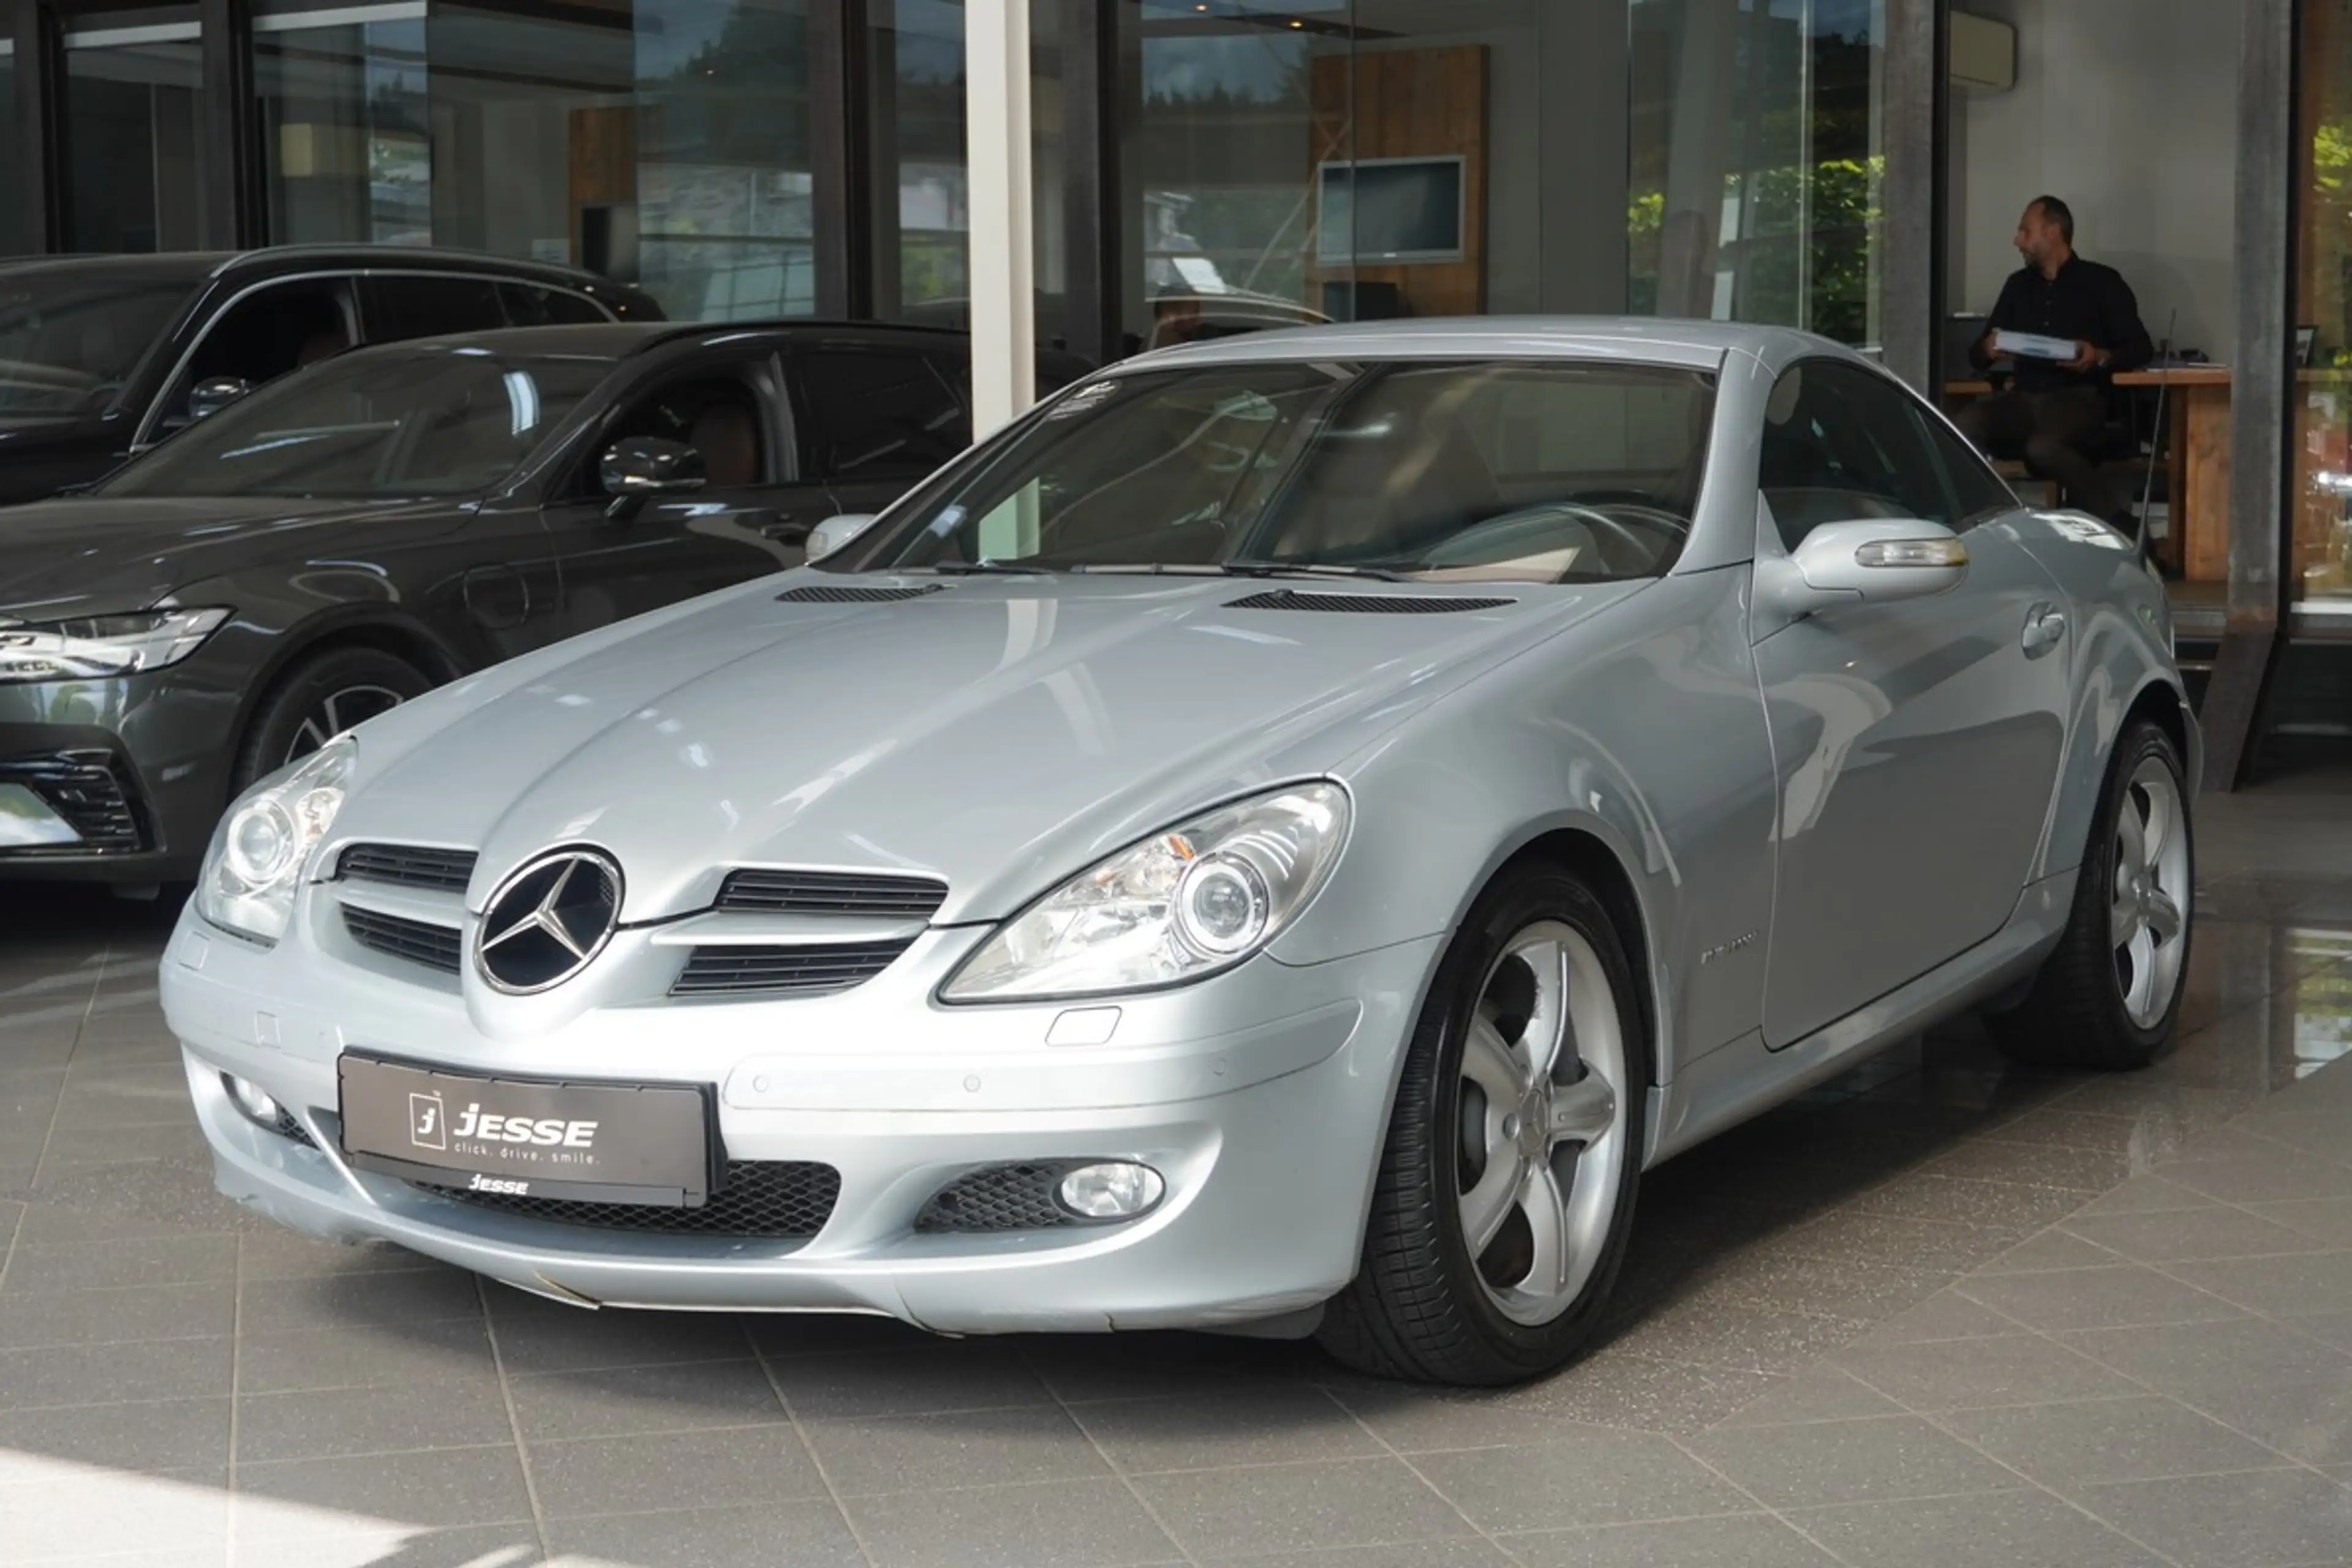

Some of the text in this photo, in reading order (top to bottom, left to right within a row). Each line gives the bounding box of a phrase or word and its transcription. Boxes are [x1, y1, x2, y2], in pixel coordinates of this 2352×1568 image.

[454, 1142, 600, 1165] click. drive. smile.
